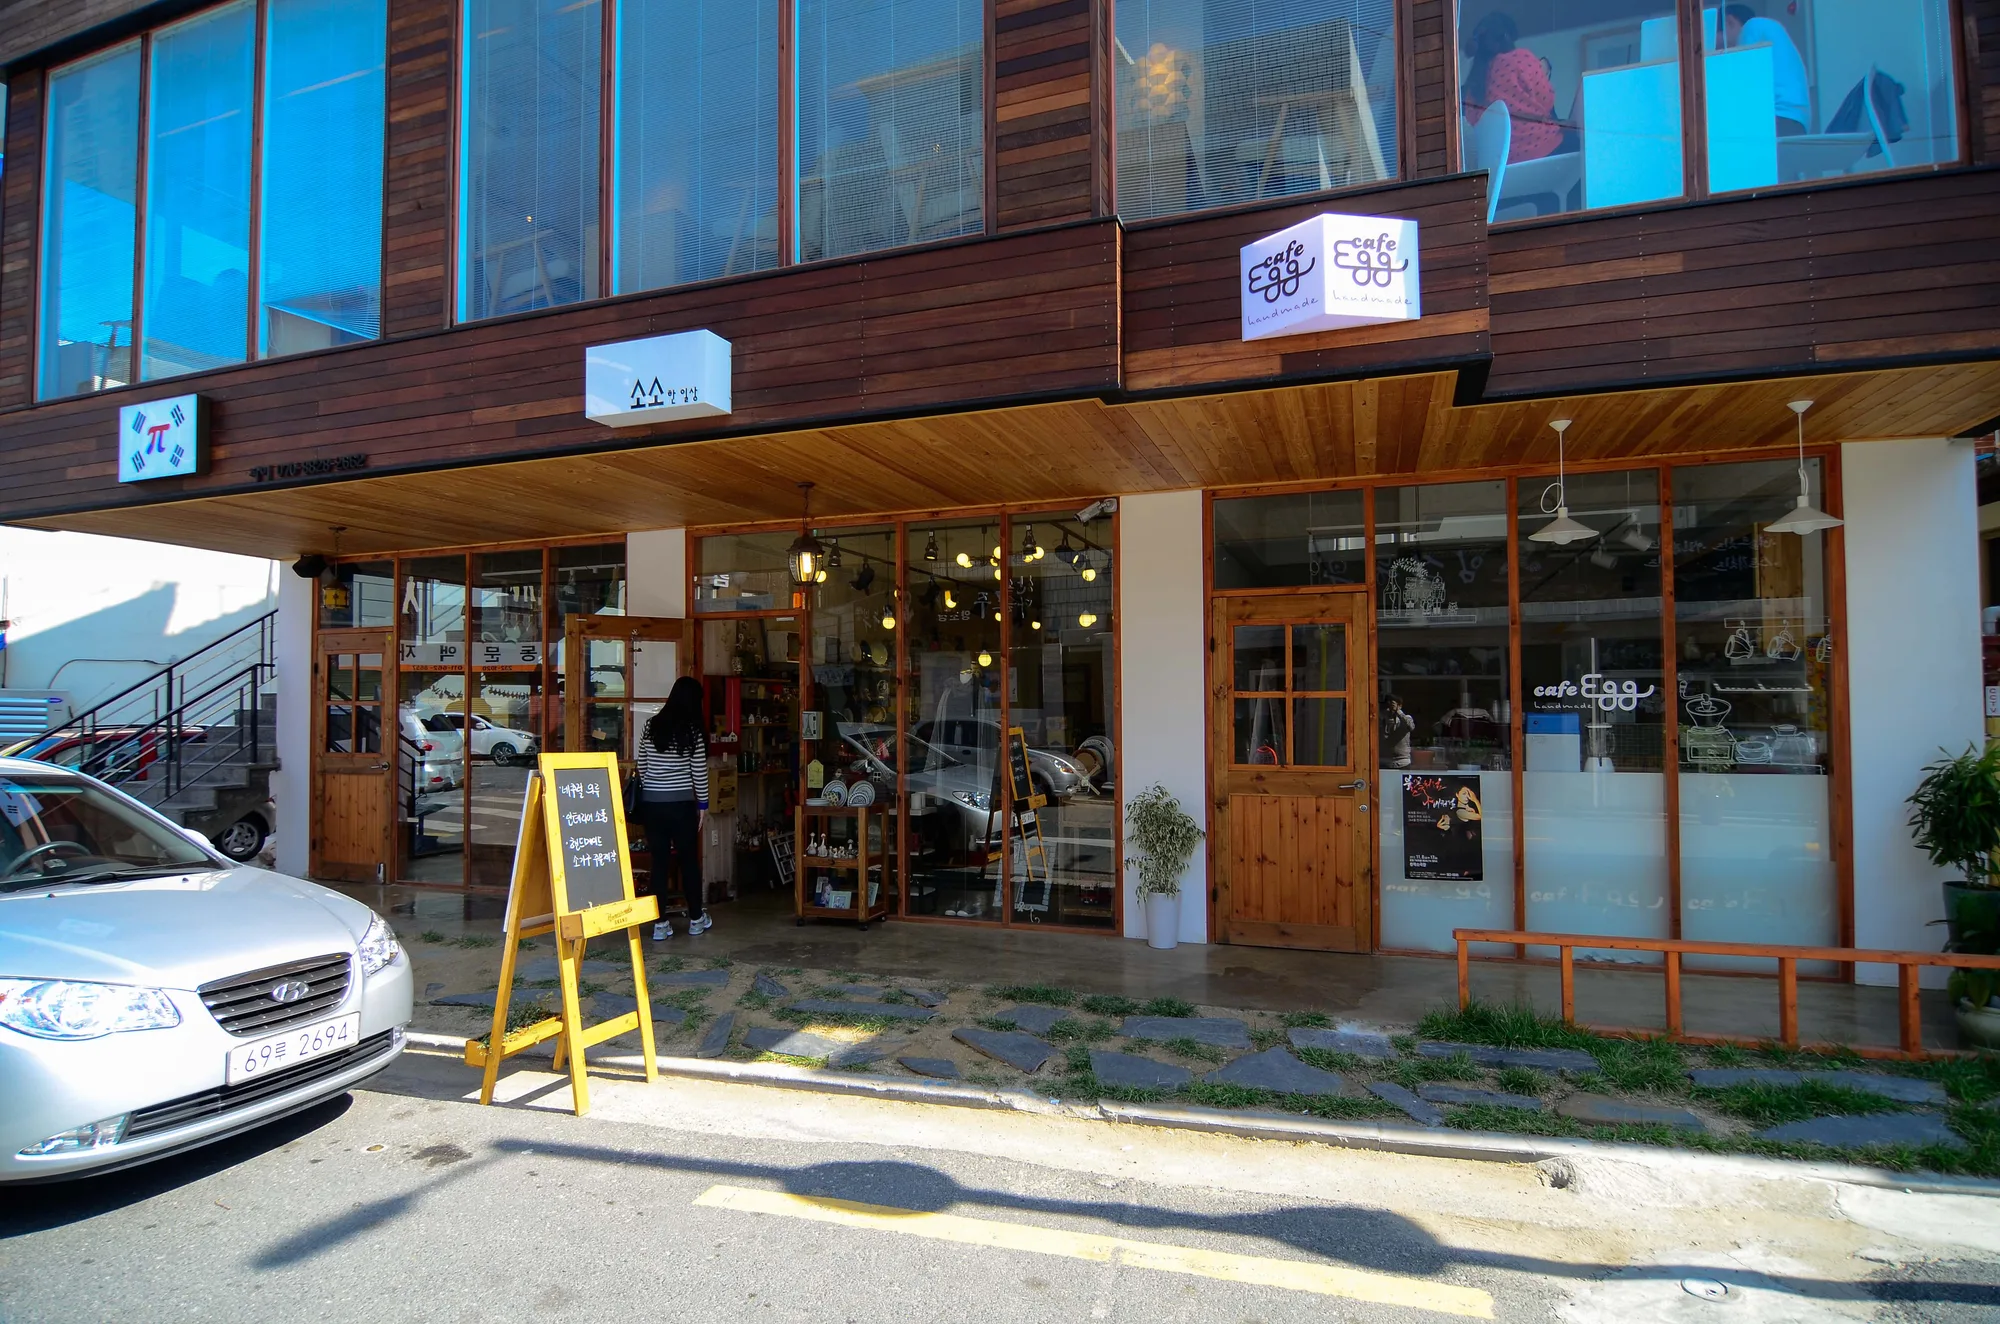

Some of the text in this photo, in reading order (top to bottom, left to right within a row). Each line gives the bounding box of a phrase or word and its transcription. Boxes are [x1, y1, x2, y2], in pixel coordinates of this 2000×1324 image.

[1263, 239, 1305, 269] cafe
[1350, 232, 1397, 253] cafe
[1333, 239, 1409, 288] Egg
[1248, 256, 1316, 304] Egg
[1247, 297, 1319, 326] handmade
[1332, 289, 1413, 305] handmade
[680, 386, 698, 403] 일상
[1533, 673, 1655, 712] cafe Egg
[1533, 701, 1594, 709] handmade
[1989, 687, 1997, 713] CCTV
[299, 1021, 348, 1057] 2694
